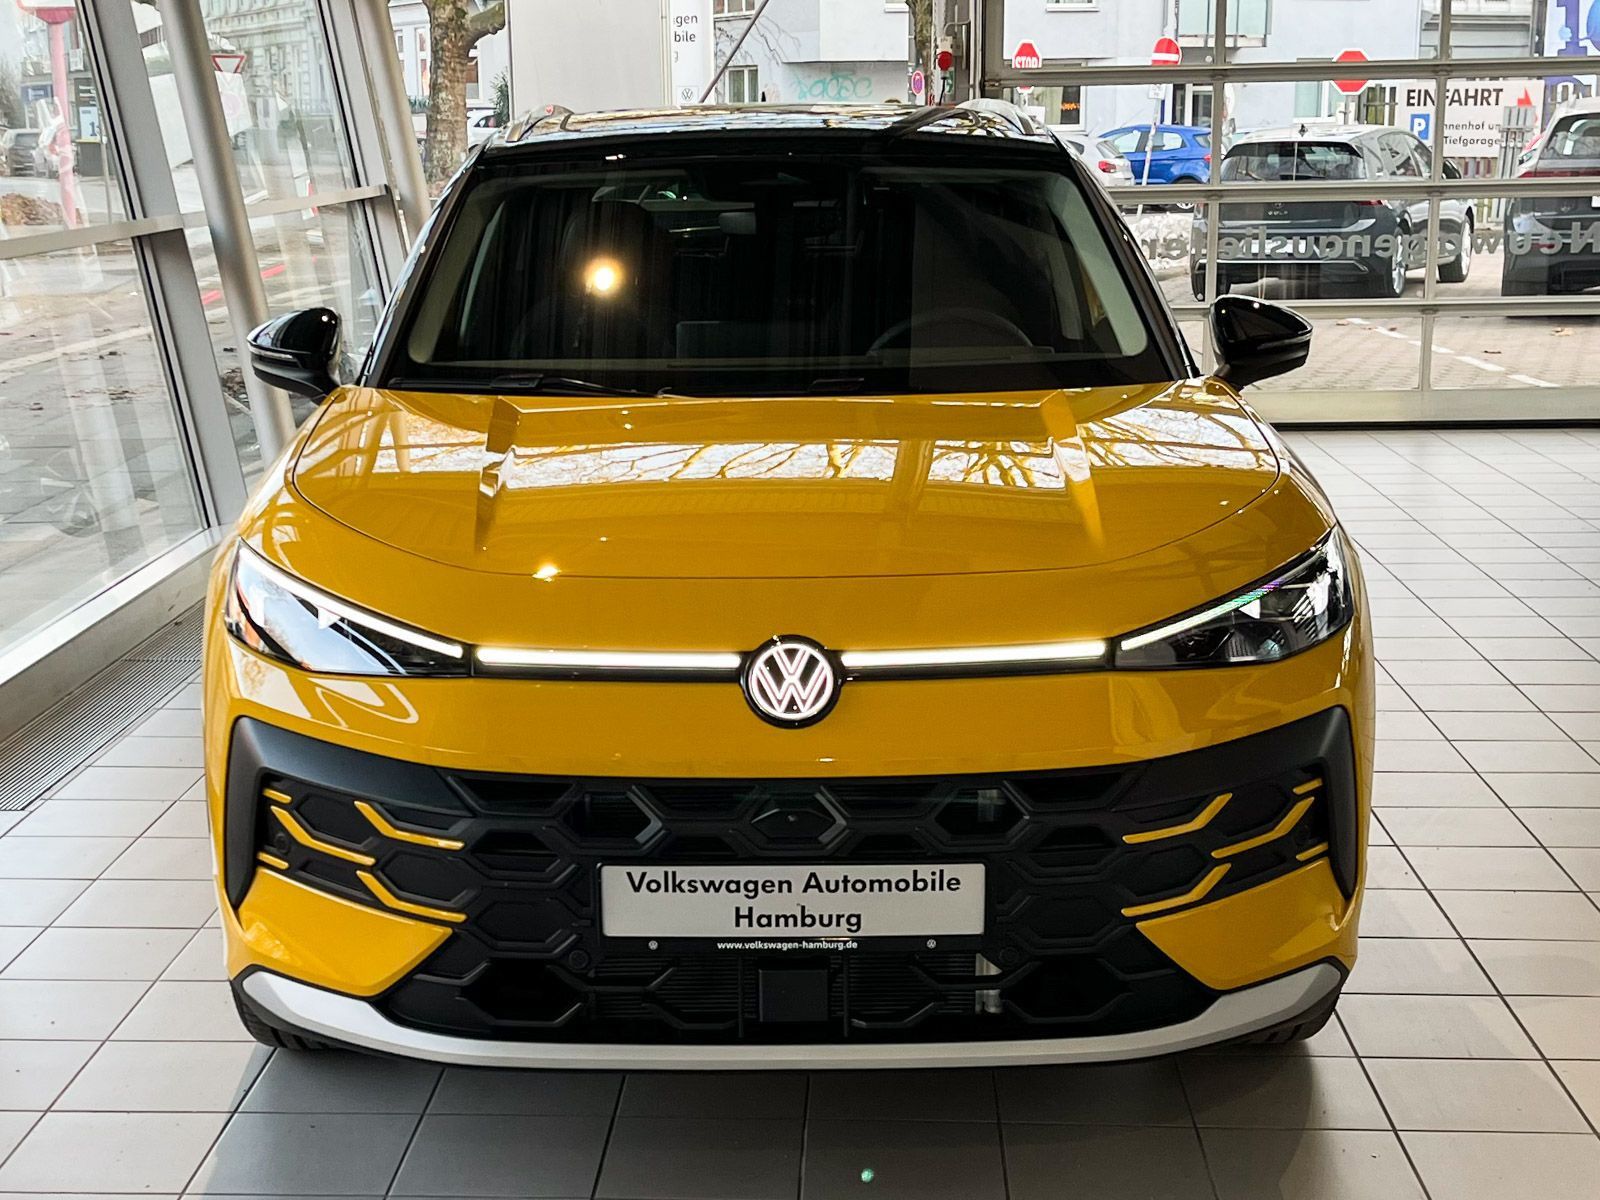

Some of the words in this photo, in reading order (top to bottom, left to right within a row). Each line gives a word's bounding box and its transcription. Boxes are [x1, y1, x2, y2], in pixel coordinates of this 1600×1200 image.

[674, 15, 698, 27] gen
[1443, 119, 1485, 131] nnenhof
[626, 870, 793, 900] Volkswagen
[802, 868, 961, 893] Automobile
[734, 905, 862, 933] Hamburg
[716, 940, 858, 951] www.volkswagen-hamburg.de
